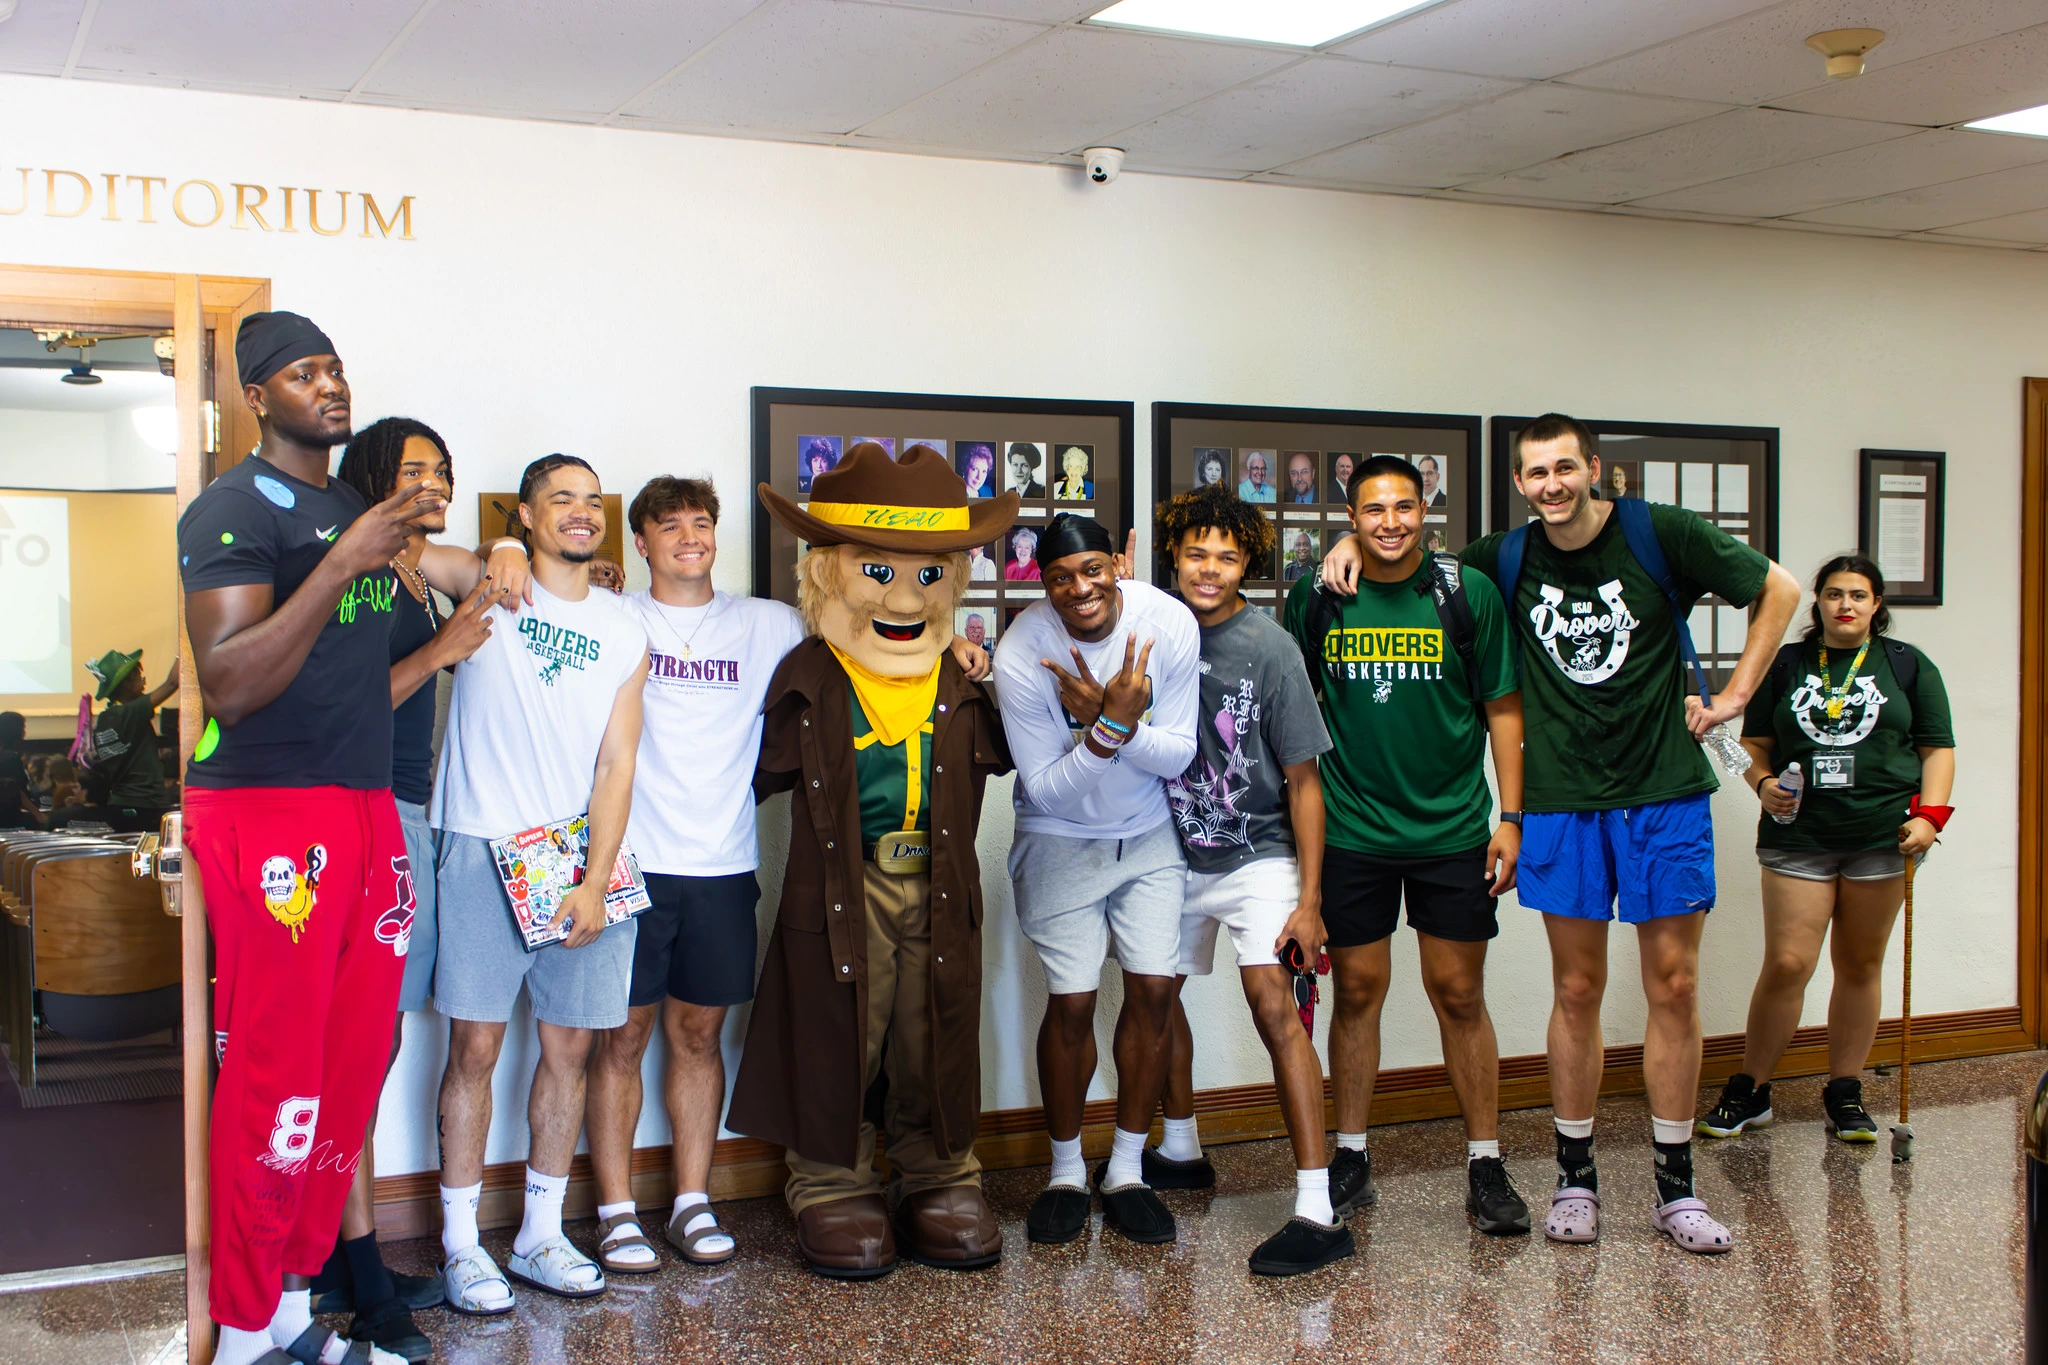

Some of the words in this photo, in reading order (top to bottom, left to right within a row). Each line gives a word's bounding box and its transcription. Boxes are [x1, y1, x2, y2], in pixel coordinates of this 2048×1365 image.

[863, 508, 944, 527] USAO
[1572, 602, 1593, 614] USAO
[1530, 604, 1640, 641] Drovers
[526, 641, 585, 671] ASKETBALL
[1327, 662, 1443, 680] SKETBALL
[630, 894, 645, 905] VISA
